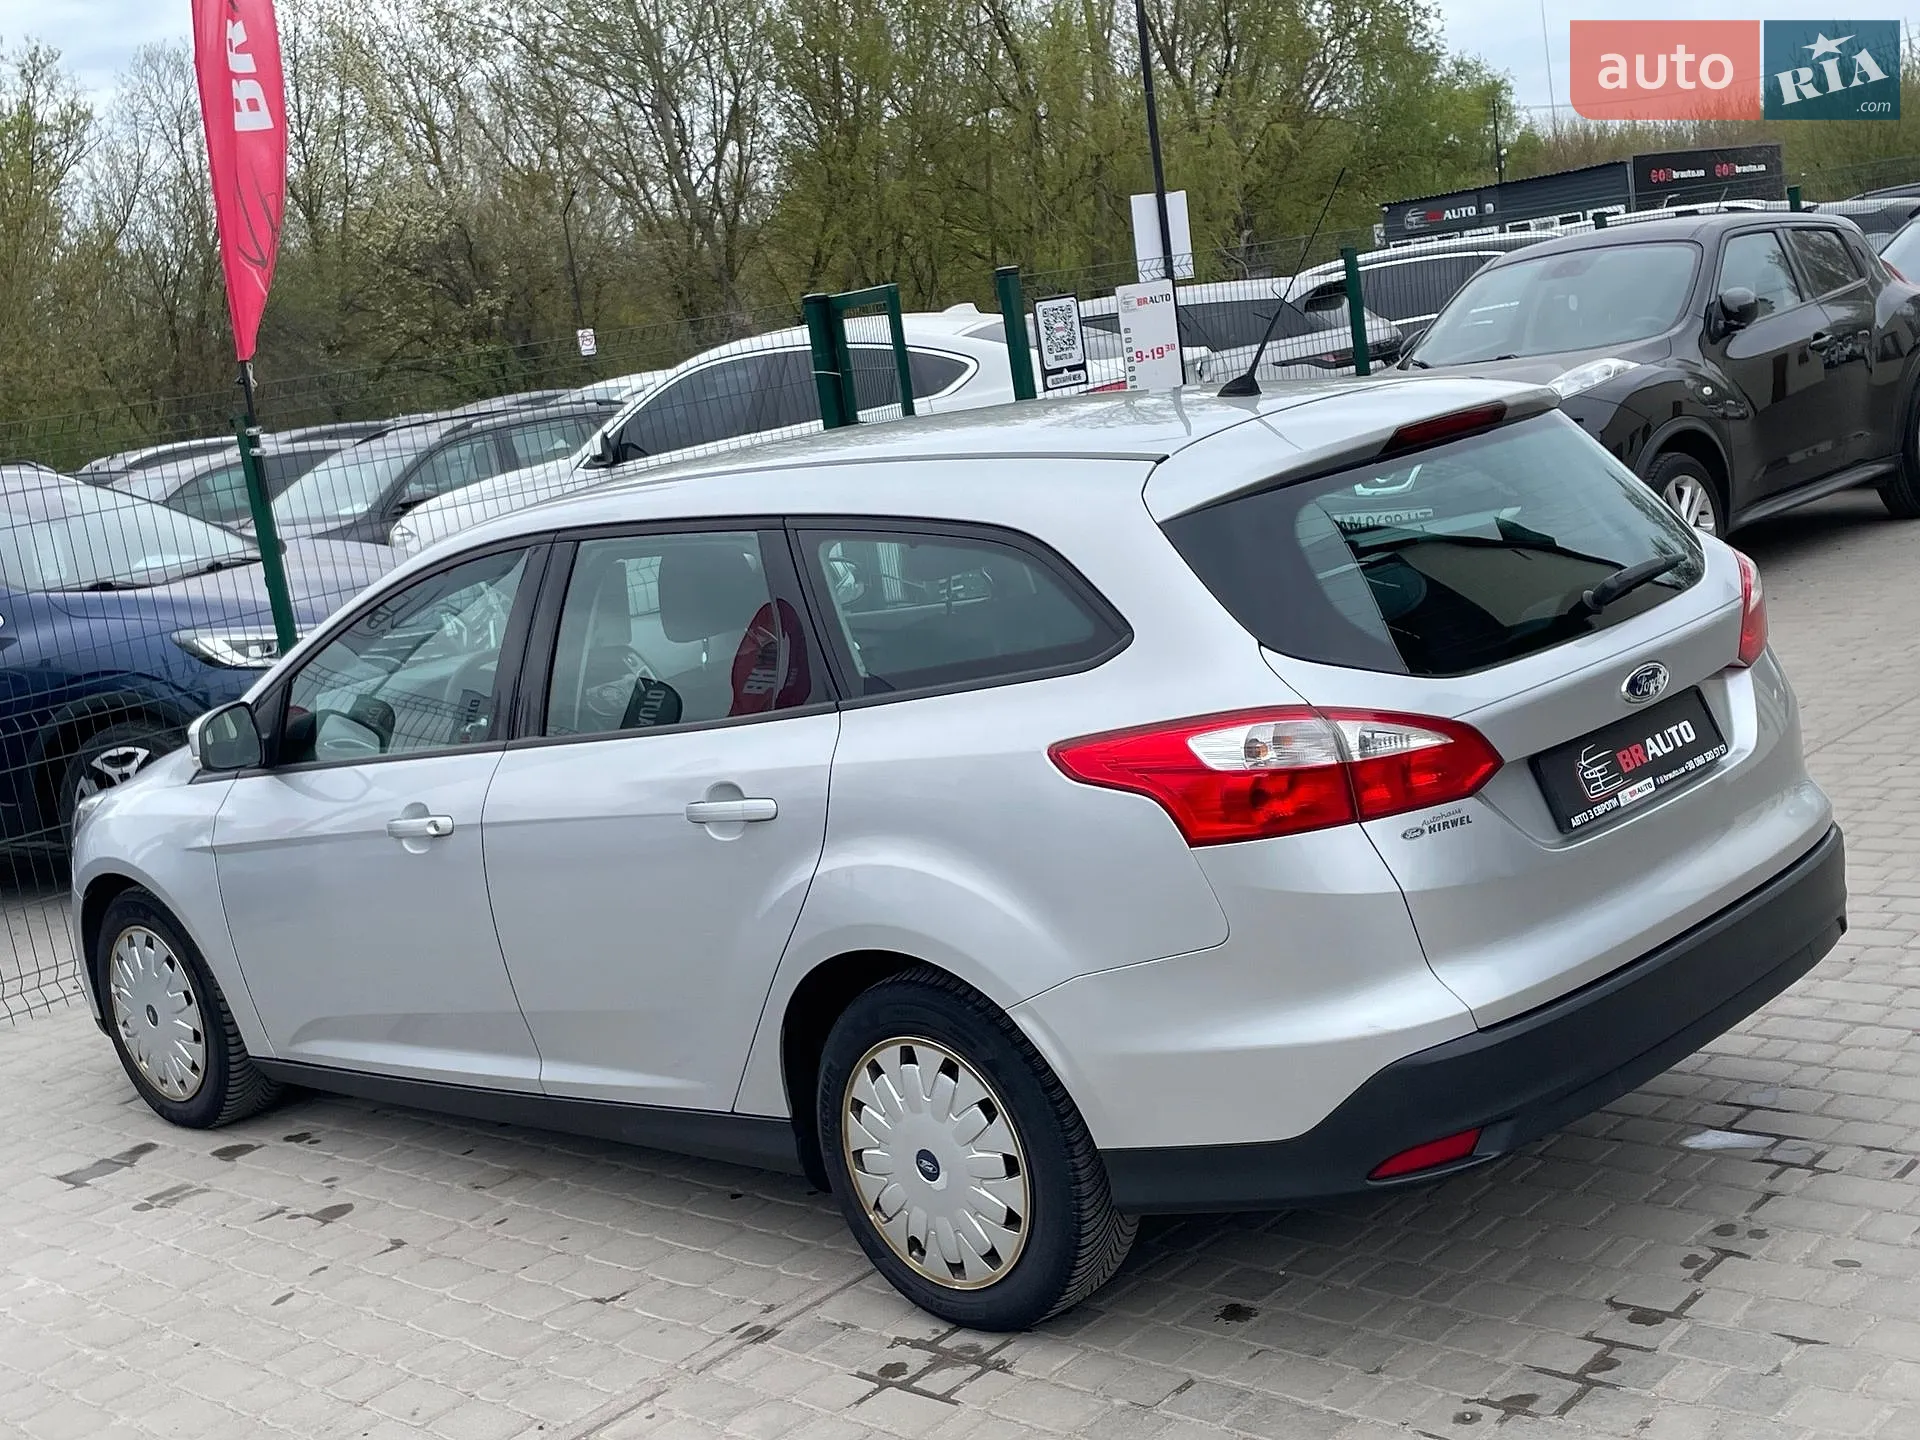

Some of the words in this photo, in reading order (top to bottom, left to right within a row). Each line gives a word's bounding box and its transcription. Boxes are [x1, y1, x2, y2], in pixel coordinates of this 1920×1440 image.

[226, 0, 275, 131] BR
[1424, 206, 1477, 222] AUTO
[1616, 720, 1696, 773] BRAUTO
[1428, 815, 1473, 834] KIRWEL
